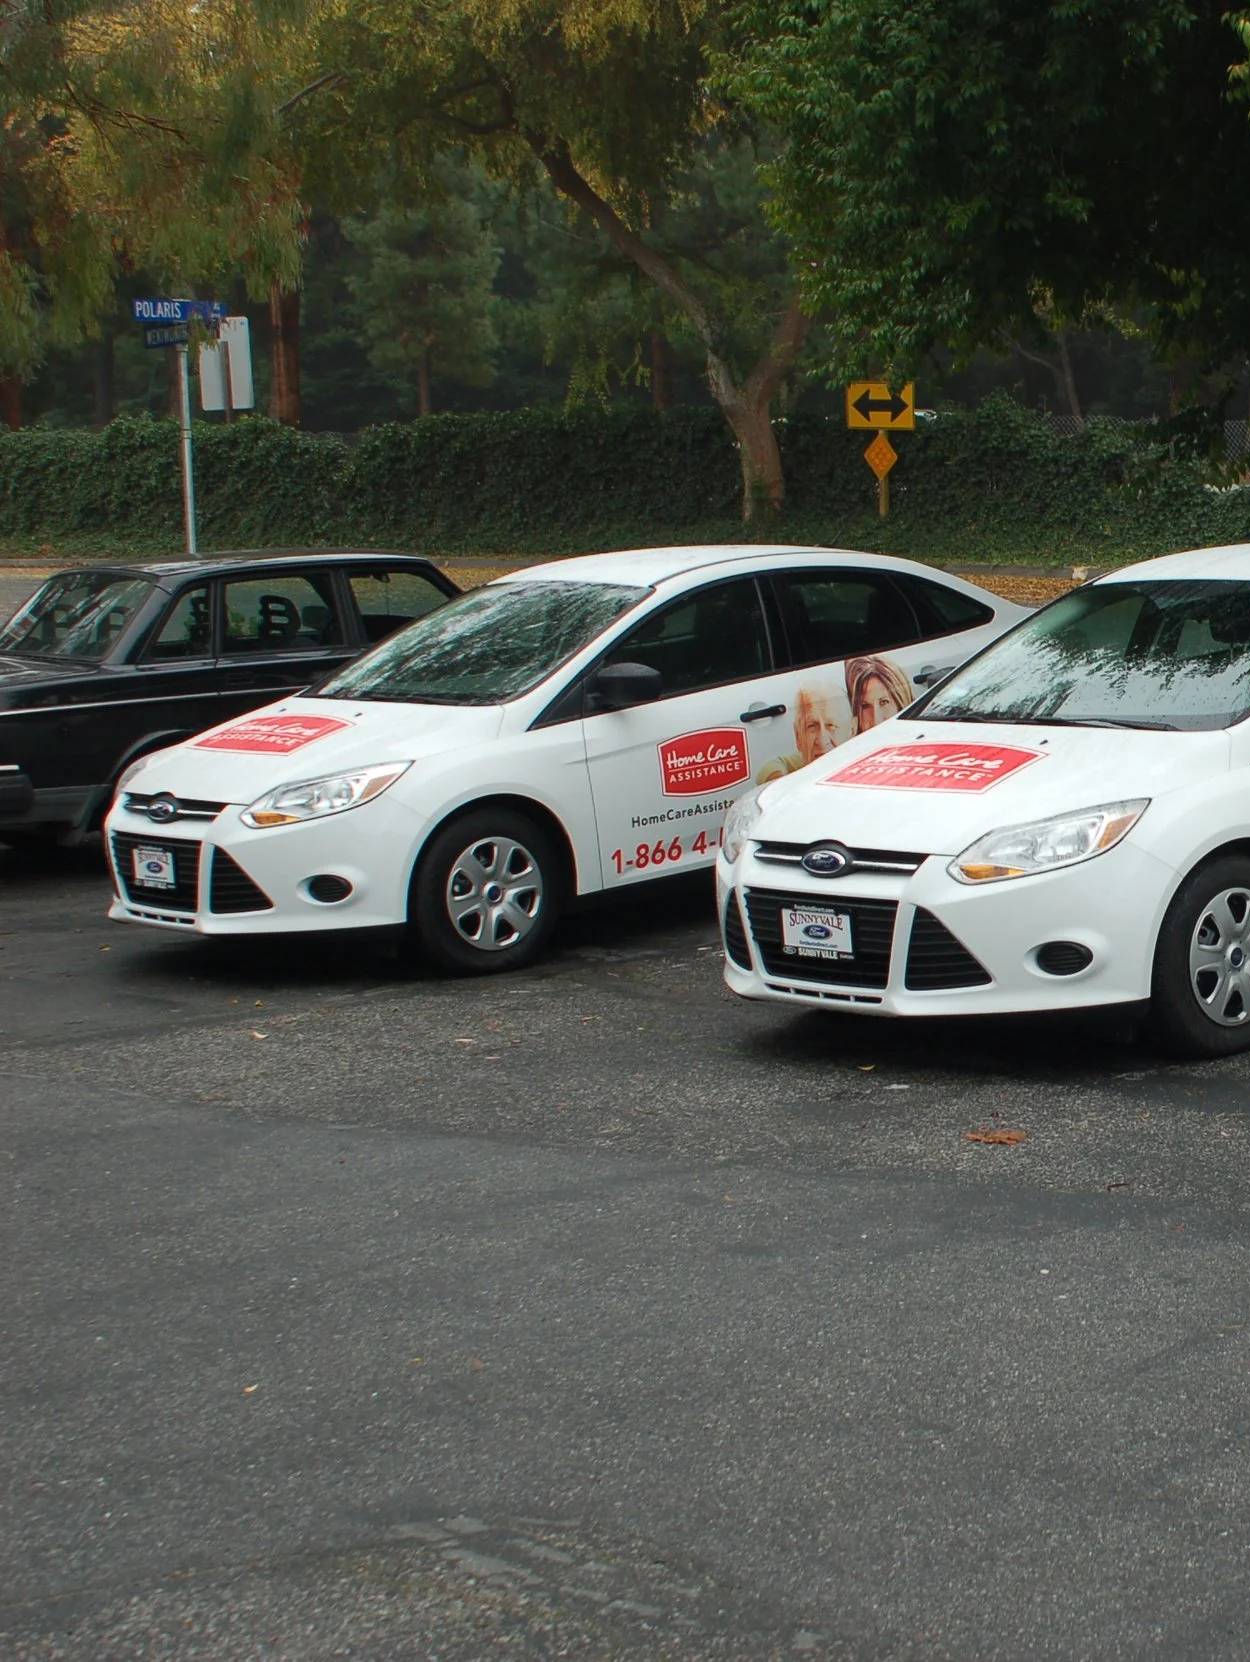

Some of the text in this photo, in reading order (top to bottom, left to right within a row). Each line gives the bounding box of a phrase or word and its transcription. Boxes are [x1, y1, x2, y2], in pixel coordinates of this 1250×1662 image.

[135, 301, 182, 319] POLARIS
[667, 744, 739, 769] Home Care
[866, 750, 1004, 769] Home Care
[669, 761, 741, 783] ASSISTANCE
[845, 766, 987, 782] ASSISTANCE
[611, 836, 683, 874] 1-866
[789, 913, 844, 931] SUNNYVALE
[808, 926, 826, 937] Ford
